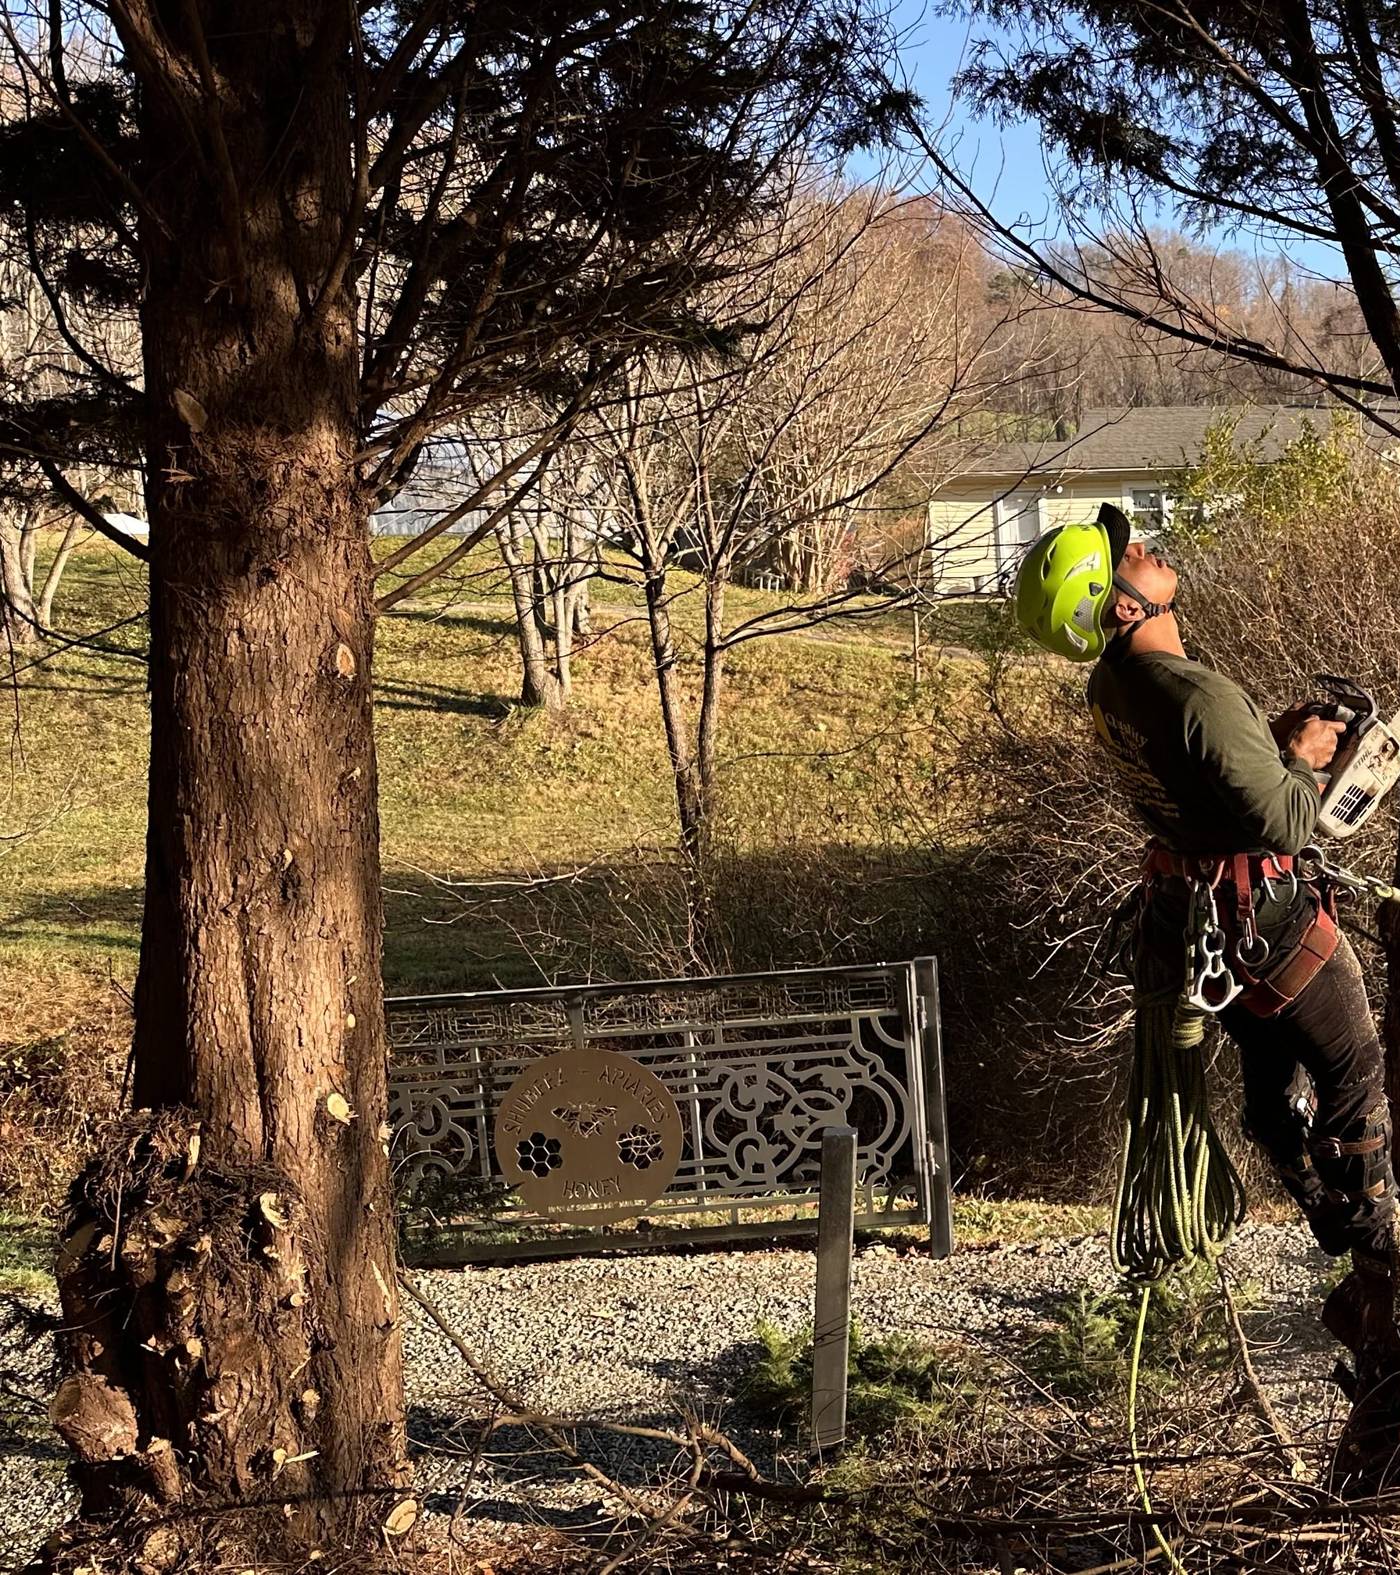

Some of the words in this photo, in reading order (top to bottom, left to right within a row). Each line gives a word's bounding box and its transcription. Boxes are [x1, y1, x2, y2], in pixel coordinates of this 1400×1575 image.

[1352, 748, 1373, 770] STIHL
[597, 1064, 671, 1125] APIARIES
[562, 1175, 622, 1199] HONEY
